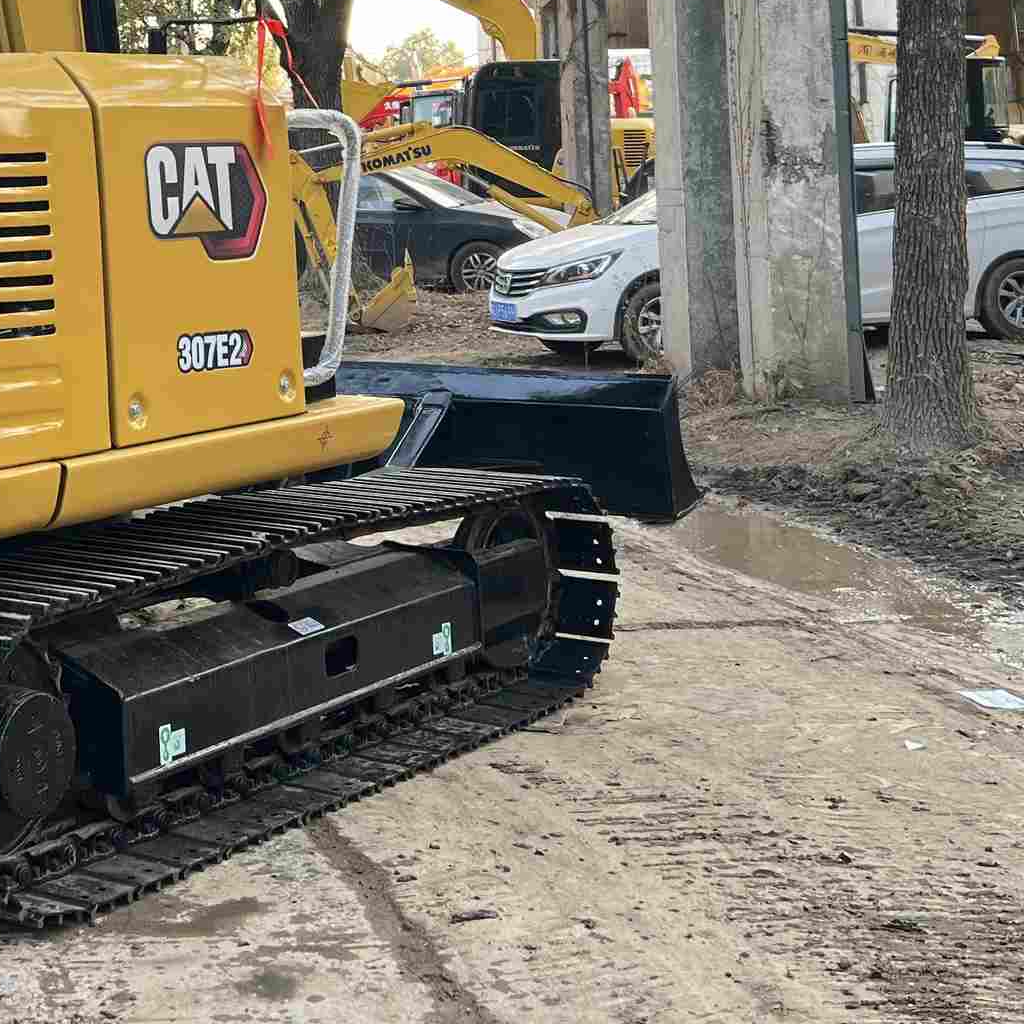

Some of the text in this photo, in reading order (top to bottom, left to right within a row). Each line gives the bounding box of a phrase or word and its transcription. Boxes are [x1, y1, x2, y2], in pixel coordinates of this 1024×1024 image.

[361, 145, 432, 173] KOMATSU
[146, 145, 236, 235] CAT
[178, 332, 243, 372] 307E2
